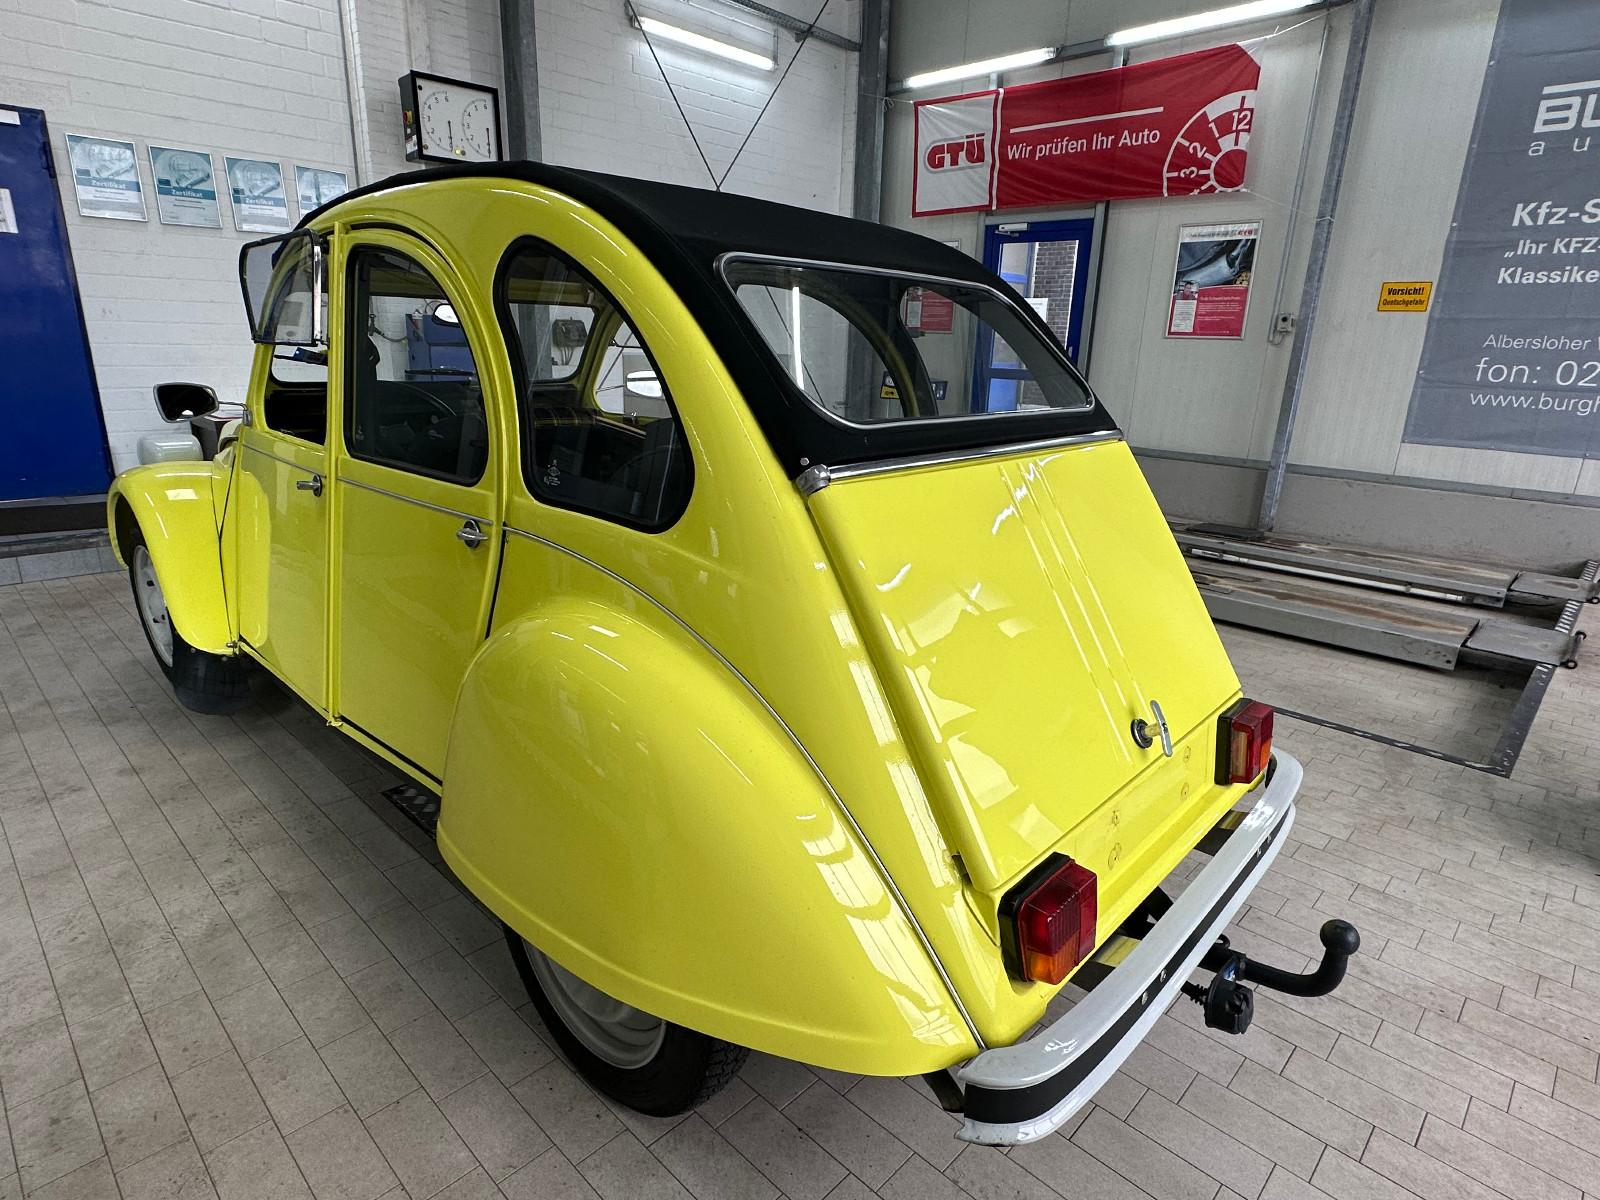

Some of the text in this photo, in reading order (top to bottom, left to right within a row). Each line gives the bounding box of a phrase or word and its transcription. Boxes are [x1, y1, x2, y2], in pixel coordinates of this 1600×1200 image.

[1208, 121, 1220, 138] 1
[1232, 110, 1251, 131] 12
[927, 132, 986, 170] GTÜ
[1007, 127, 1161, 161] Wir prüfen Ihr Auto
[1189, 142, 1207, 158] 2
[1180, 166, 1198, 178] 3
[1512, 198, 1600, 227] Kfz-S
[1387, 286, 1424, 296] Vorsicht!
[1483, 334, 1592, 350] Albersloher
[1475, 357, 1541, 384] fon:
